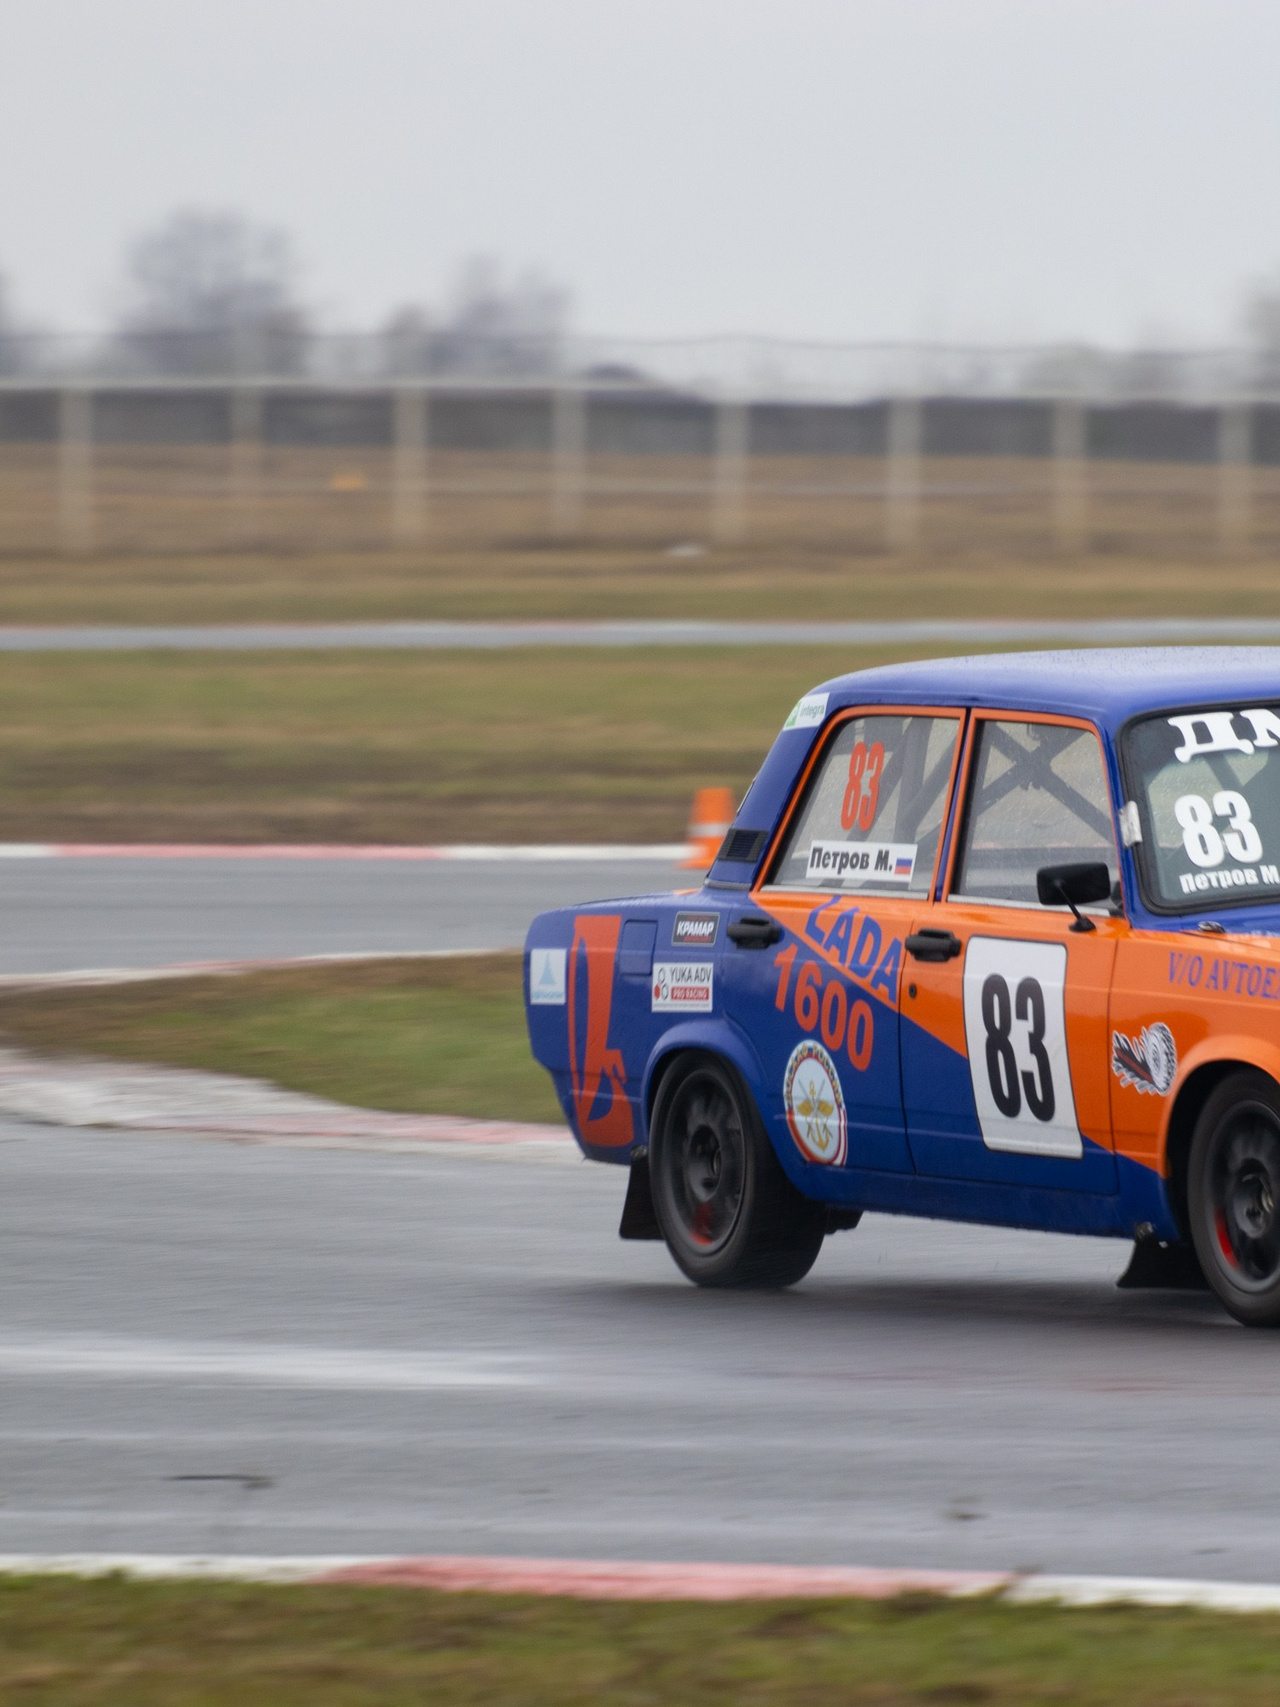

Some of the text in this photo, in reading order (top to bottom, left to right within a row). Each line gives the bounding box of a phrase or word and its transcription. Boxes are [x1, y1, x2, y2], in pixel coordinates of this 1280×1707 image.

[840, 741, 885, 831] 83
[809, 846, 893, 875] Петров М.
[1174, 790, 1264, 868] 83
[676, 920, 715, 937] КРАМАР
[804, 893, 903, 1005] LADA
[669, 966, 712, 983] YUKA ADV
[773, 942, 874, 1072] 1600
[1168, 951, 1204, 987] V/O
[981, 973, 1056, 1122] 83
